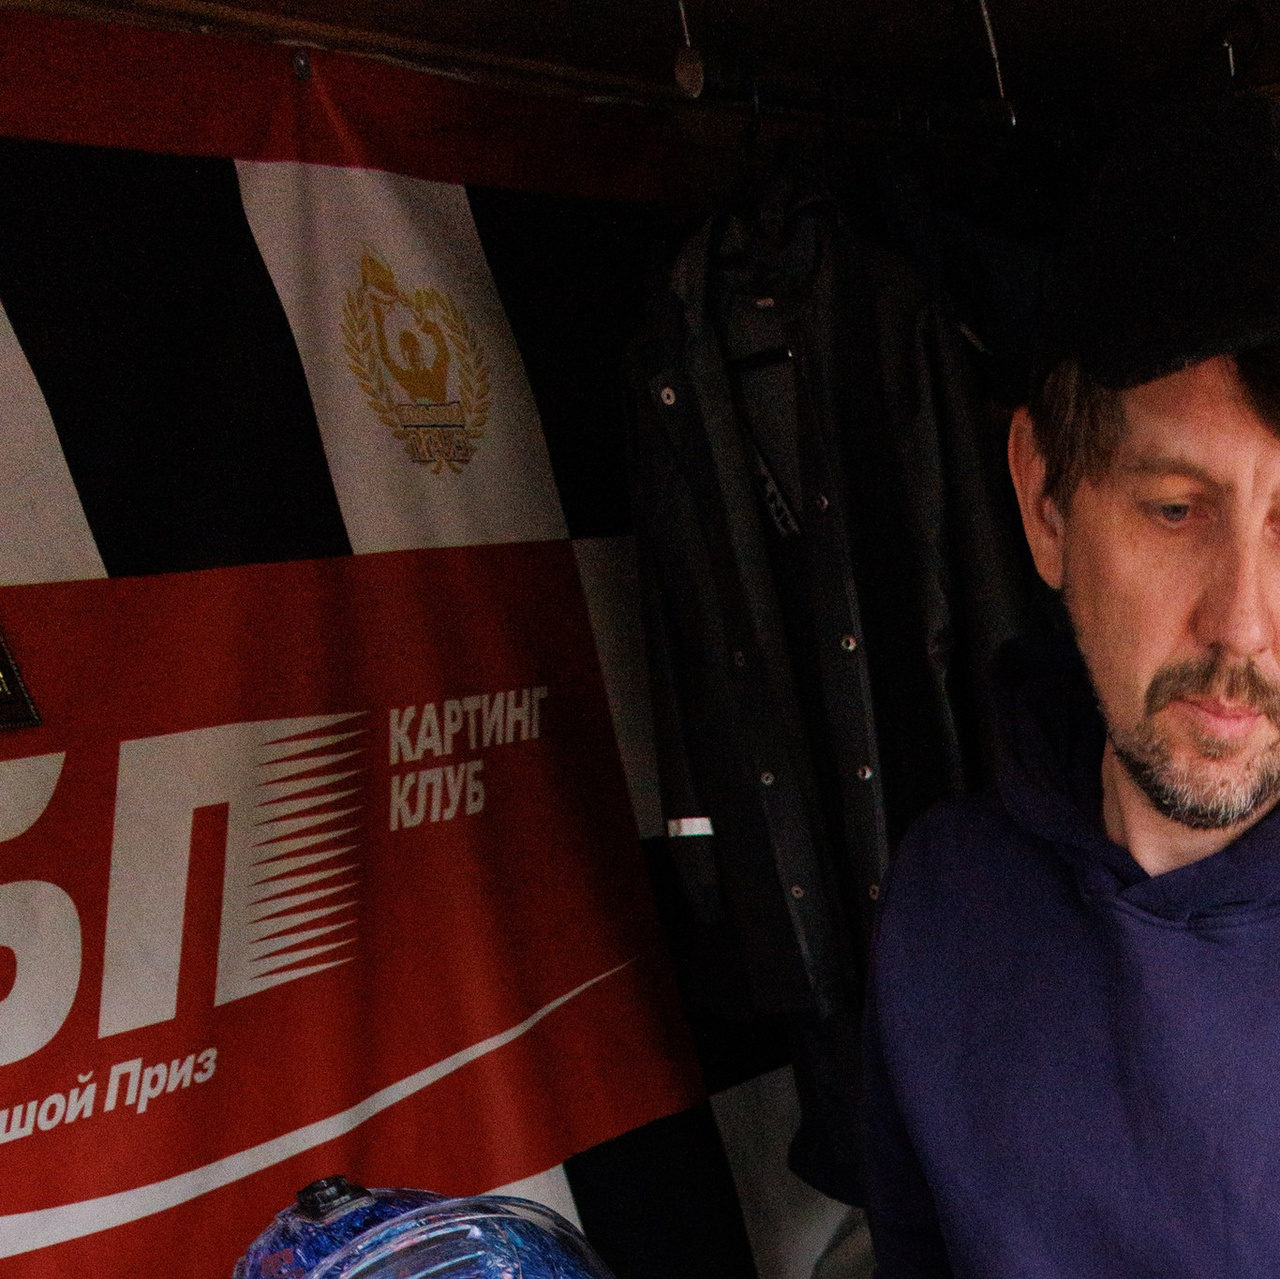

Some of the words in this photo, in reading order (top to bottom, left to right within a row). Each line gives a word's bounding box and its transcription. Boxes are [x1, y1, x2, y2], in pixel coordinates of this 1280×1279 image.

[389, 686, 549, 766] КАРТИНГ
[389, 758, 485, 832] КЛУБ
[103, 1047, 218, 1115] Приз
